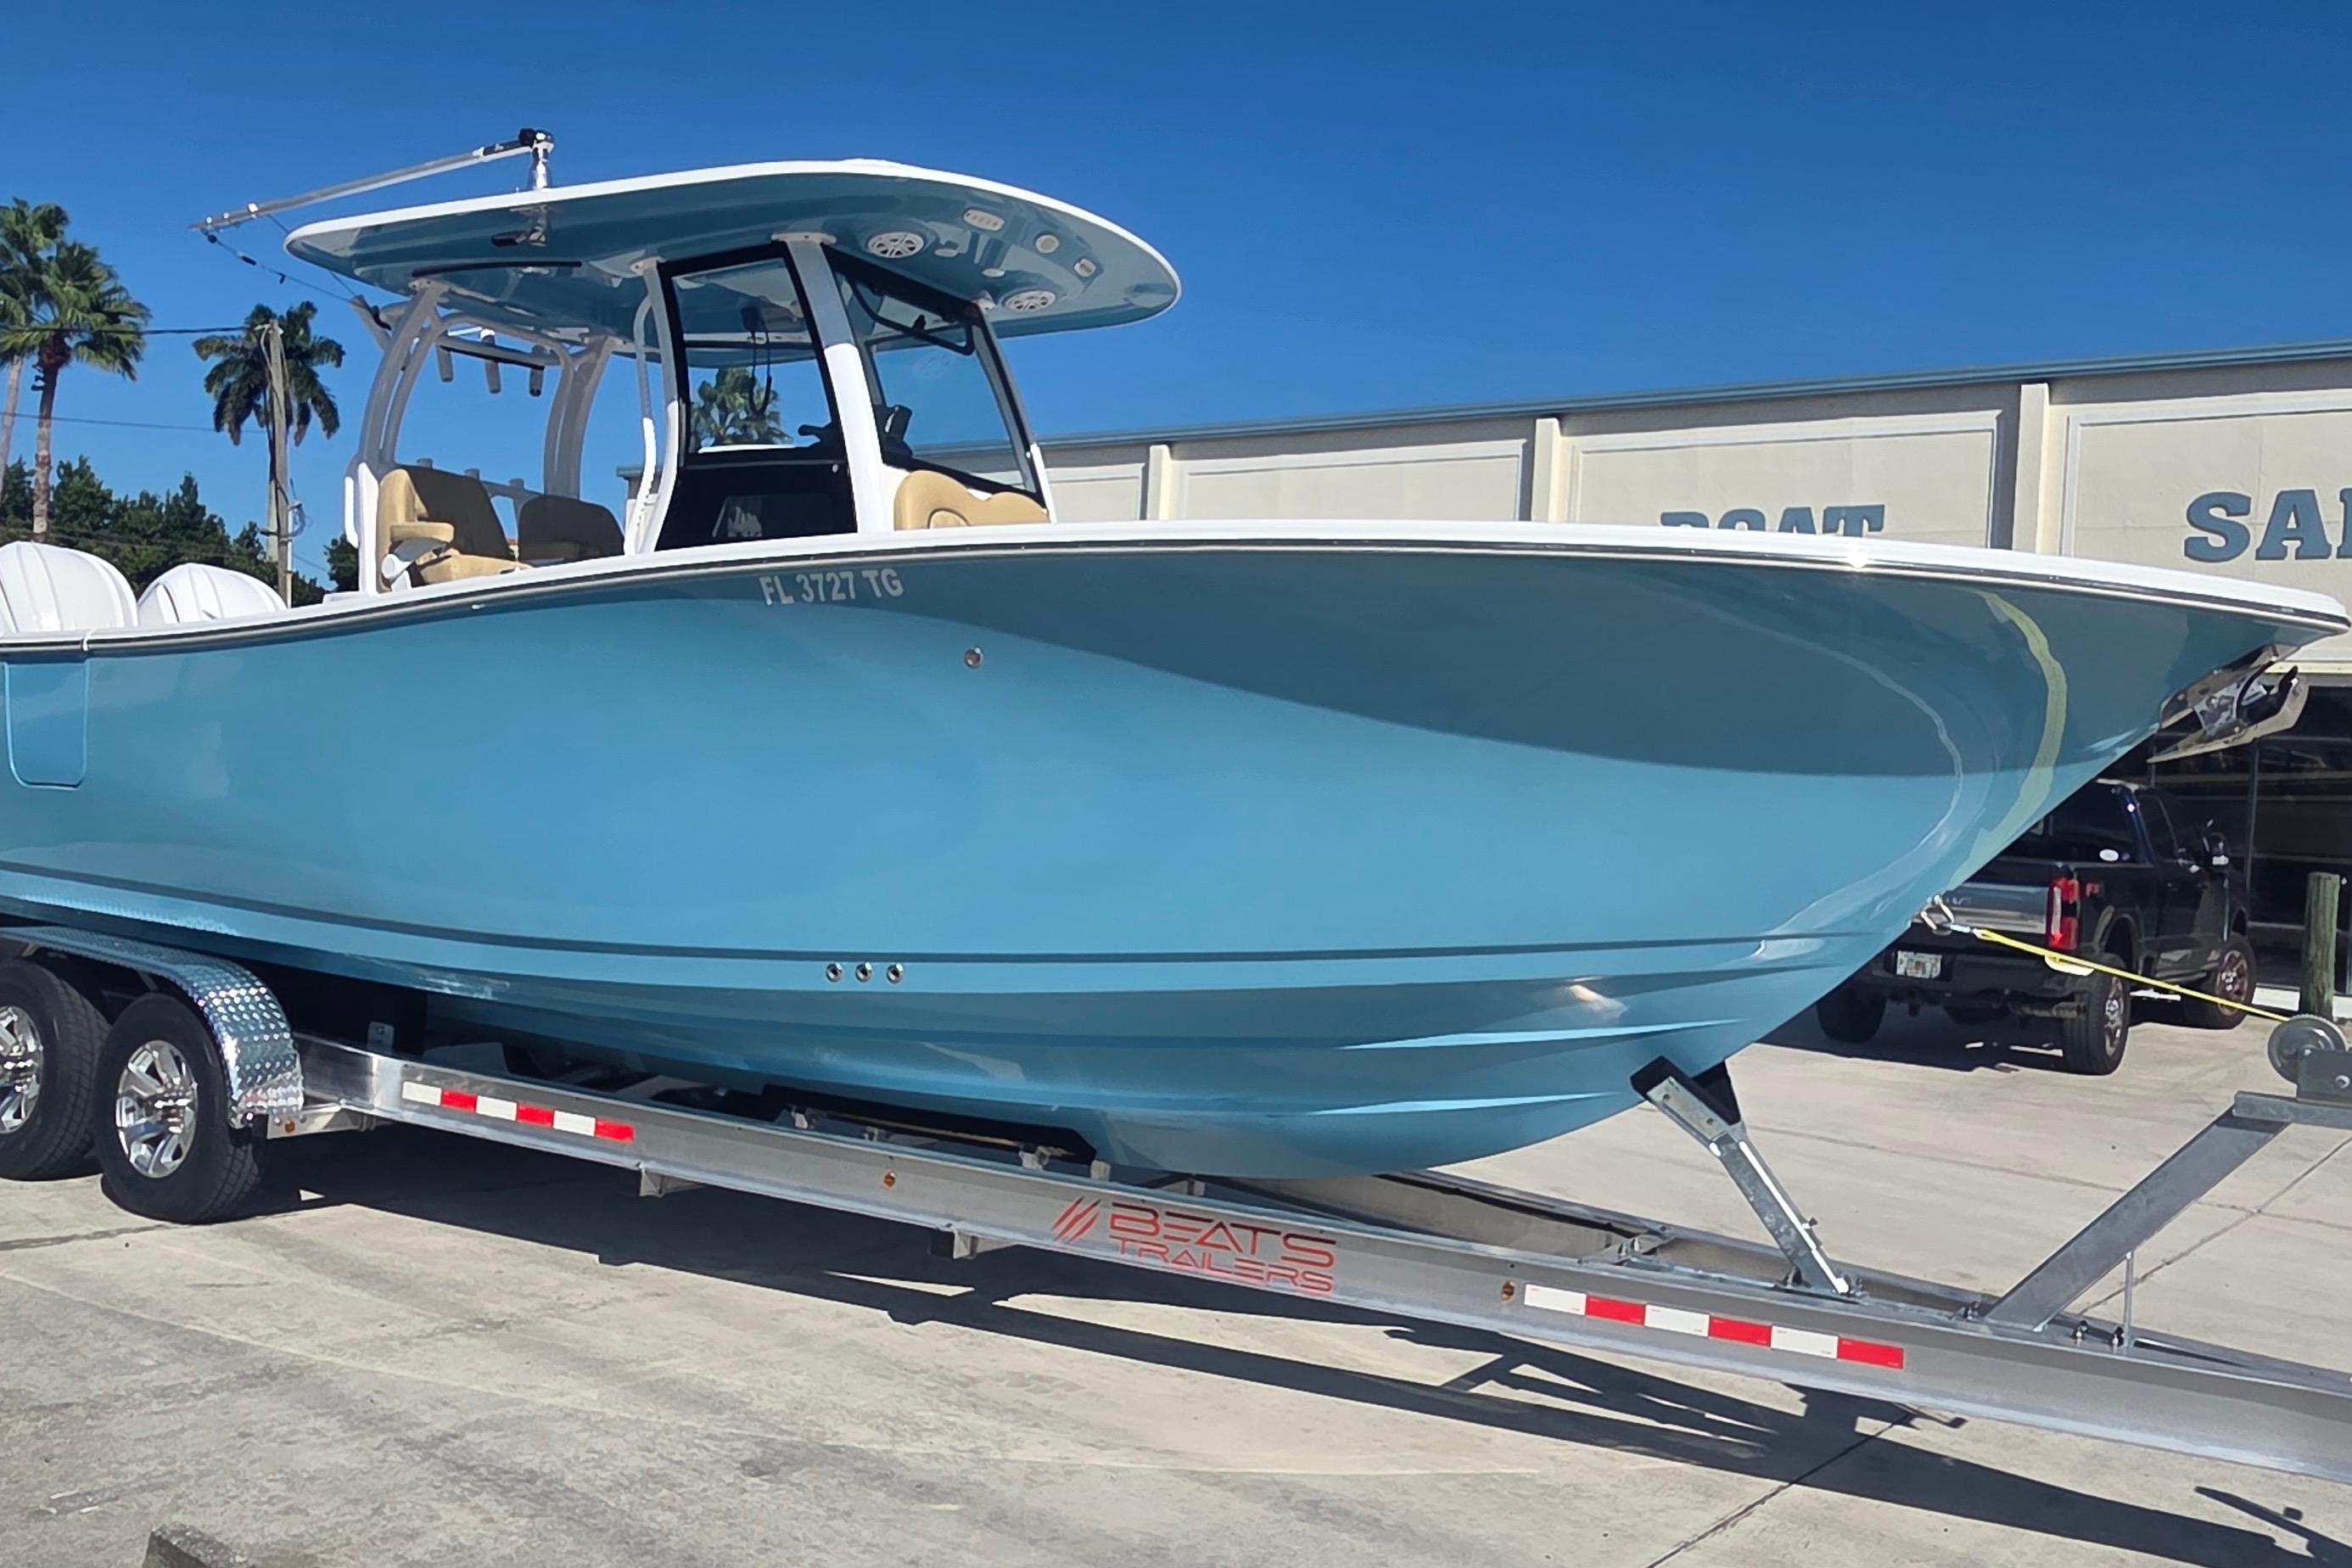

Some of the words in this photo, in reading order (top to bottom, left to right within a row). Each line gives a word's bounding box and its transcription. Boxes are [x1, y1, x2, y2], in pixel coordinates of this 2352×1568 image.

[2183, 487, 2352, 563] SA
[759, 575, 794, 605] FL
[796, 572, 855, 602] 3727
[862, 568, 903, 597] TG
[1109, 1235, 1335, 1294] TRAILERS
[1110, 1201, 1336, 1268] BEATS
